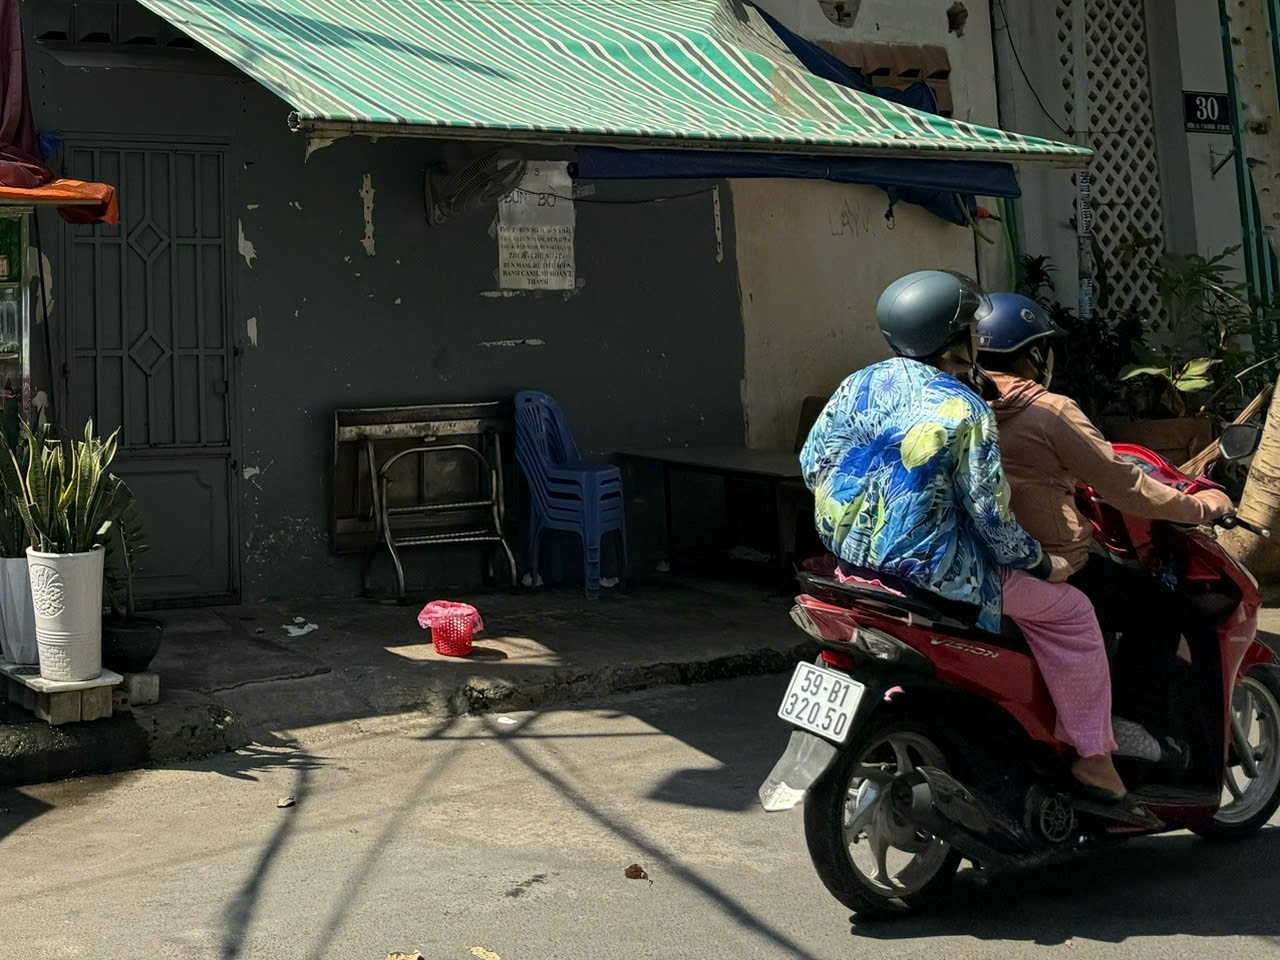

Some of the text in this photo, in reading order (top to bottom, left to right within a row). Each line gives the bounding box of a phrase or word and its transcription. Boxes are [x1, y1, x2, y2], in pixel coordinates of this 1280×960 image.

[1195, 96, 1219, 120] 30
[801, 670, 850, 707] 59-B1
[785, 693, 847, 735] 320.50
